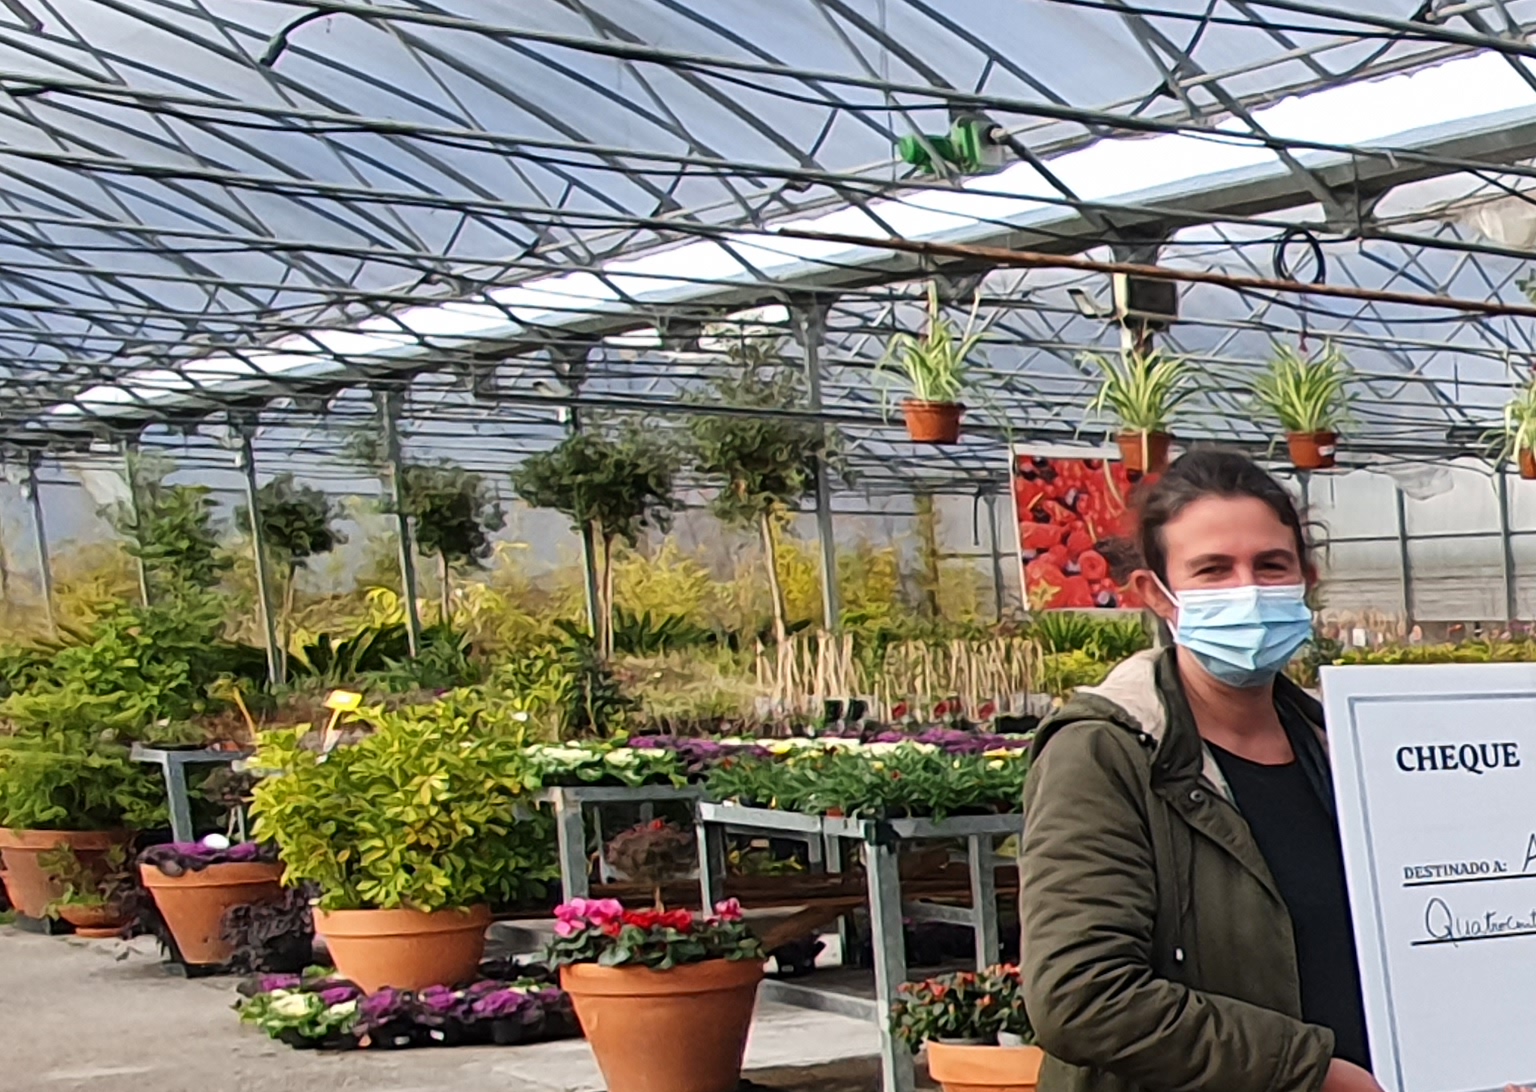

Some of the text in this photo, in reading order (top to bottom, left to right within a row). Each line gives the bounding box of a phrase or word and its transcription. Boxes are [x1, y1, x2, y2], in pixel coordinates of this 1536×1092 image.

[1396, 742, 1521, 774] CHEQUE
[1404, 861, 1508, 880] DESTINADO A:
